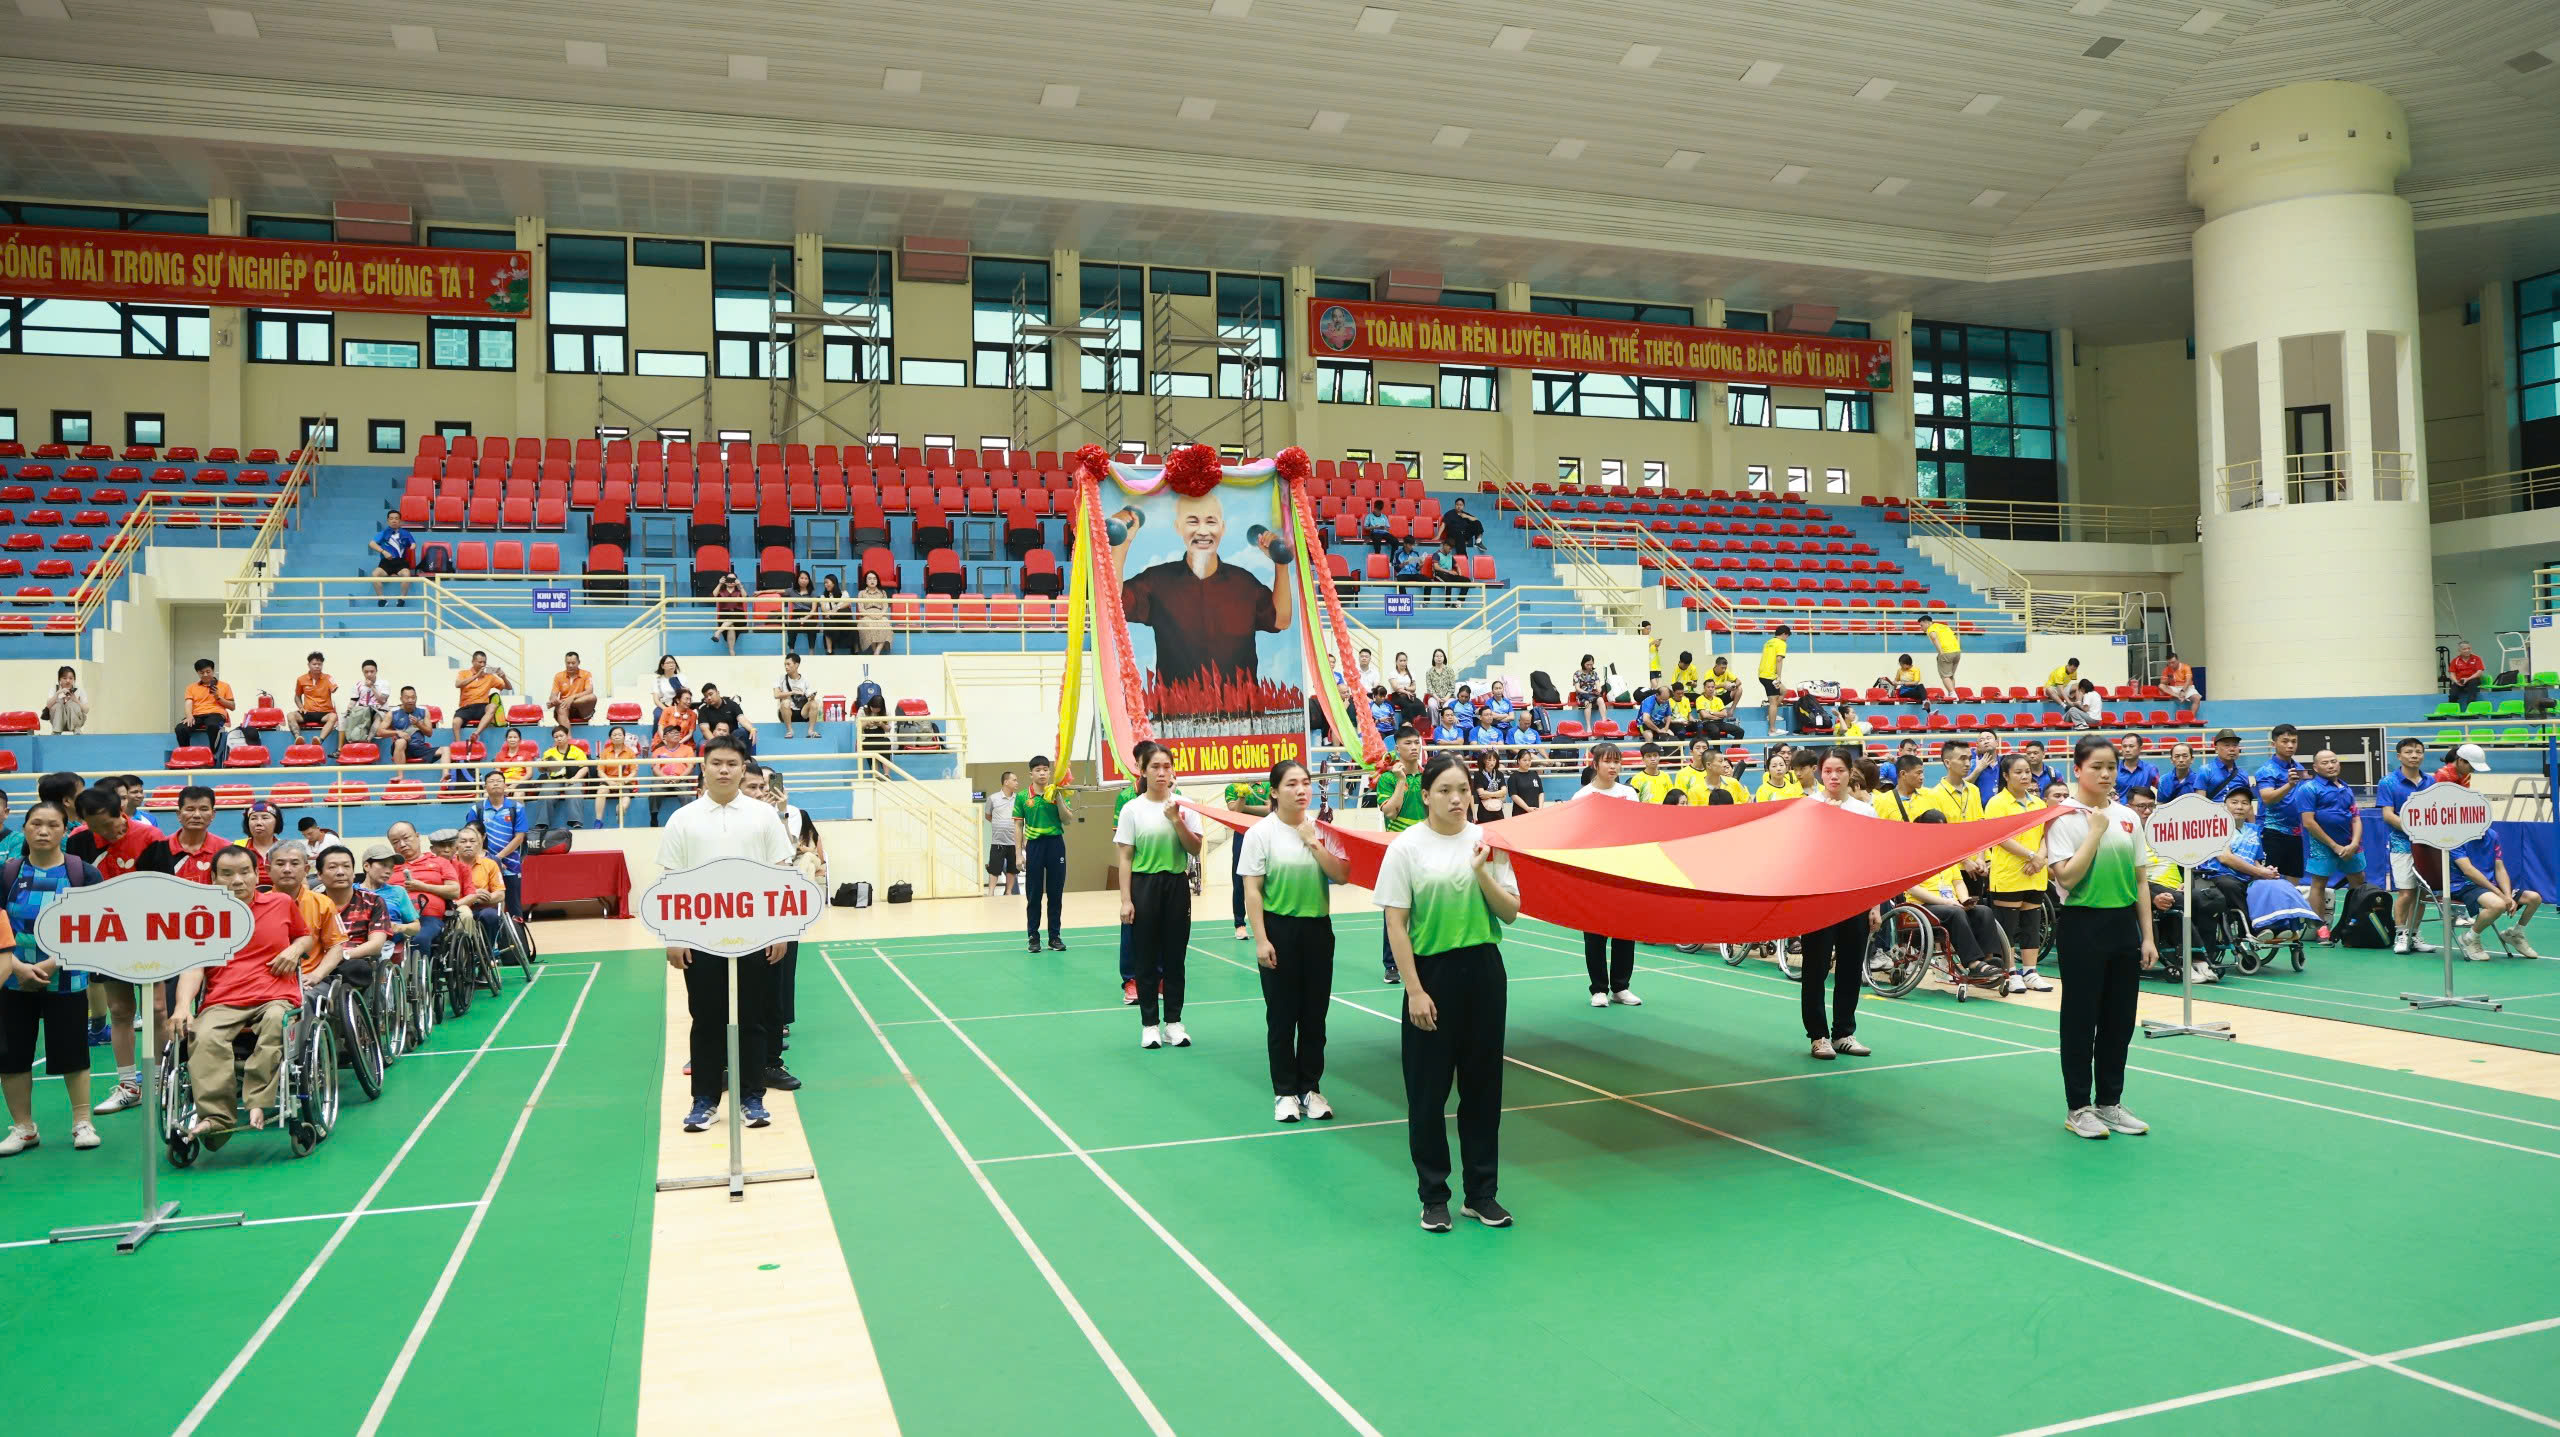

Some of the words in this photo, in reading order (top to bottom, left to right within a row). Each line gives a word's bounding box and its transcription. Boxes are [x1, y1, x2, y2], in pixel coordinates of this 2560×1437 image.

[60, 241, 104, 283] MÃI
[111, 249, 185, 286] TRONG
[192, 251, 224, 295] SỰ
[228, 251, 308, 298] NGHIỆP
[314, 250, 356, 294] CỦA
[362, 258, 433, 298] CHÚNG
[438, 266, 462, 298] TA
[468, 267, 475, 298] !
[1365, 315, 1414, 349] TOÀN
[1419, 318, 1457, 351] DÂN
[1461, 321, 1497, 354] RÈN
[1502, 324, 1556, 363] LUYỆN
[1560, 328, 1605, 361] THÂN
[1609, 328, 1640, 364] THỂ
[1643, 339, 1684, 368] THEO
[1689, 341, 1743, 371] GƯƠNG
[1747, 342, 1778, 374] BÁC
[1782, 343, 1803, 375] HỒ
[1806, 347, 1822, 377] VĨ
[1824, 352, 1850, 383] ĐẠI
[1855, 355, 1860, 379] !
[1200, 740, 1229, 771] NÀO
[1232, 740, 1270, 770] CŨNG
[2153, 817, 2179, 843] THÁI
[2182, 813, 2228, 841] NGUYÊN
[2408, 808, 2422, 827] TP.
[2424, 801, 2438, 826] HỒ
[2440, 802, 2457, 825] CHÍ
[2460, 805, 2486, 824] MINH
[59, 907, 128, 944] HÀ
[146, 905, 232, 946] NỘI
[656, 891, 754, 926] TRỌNG
[763, 884, 808, 917] TÀI
